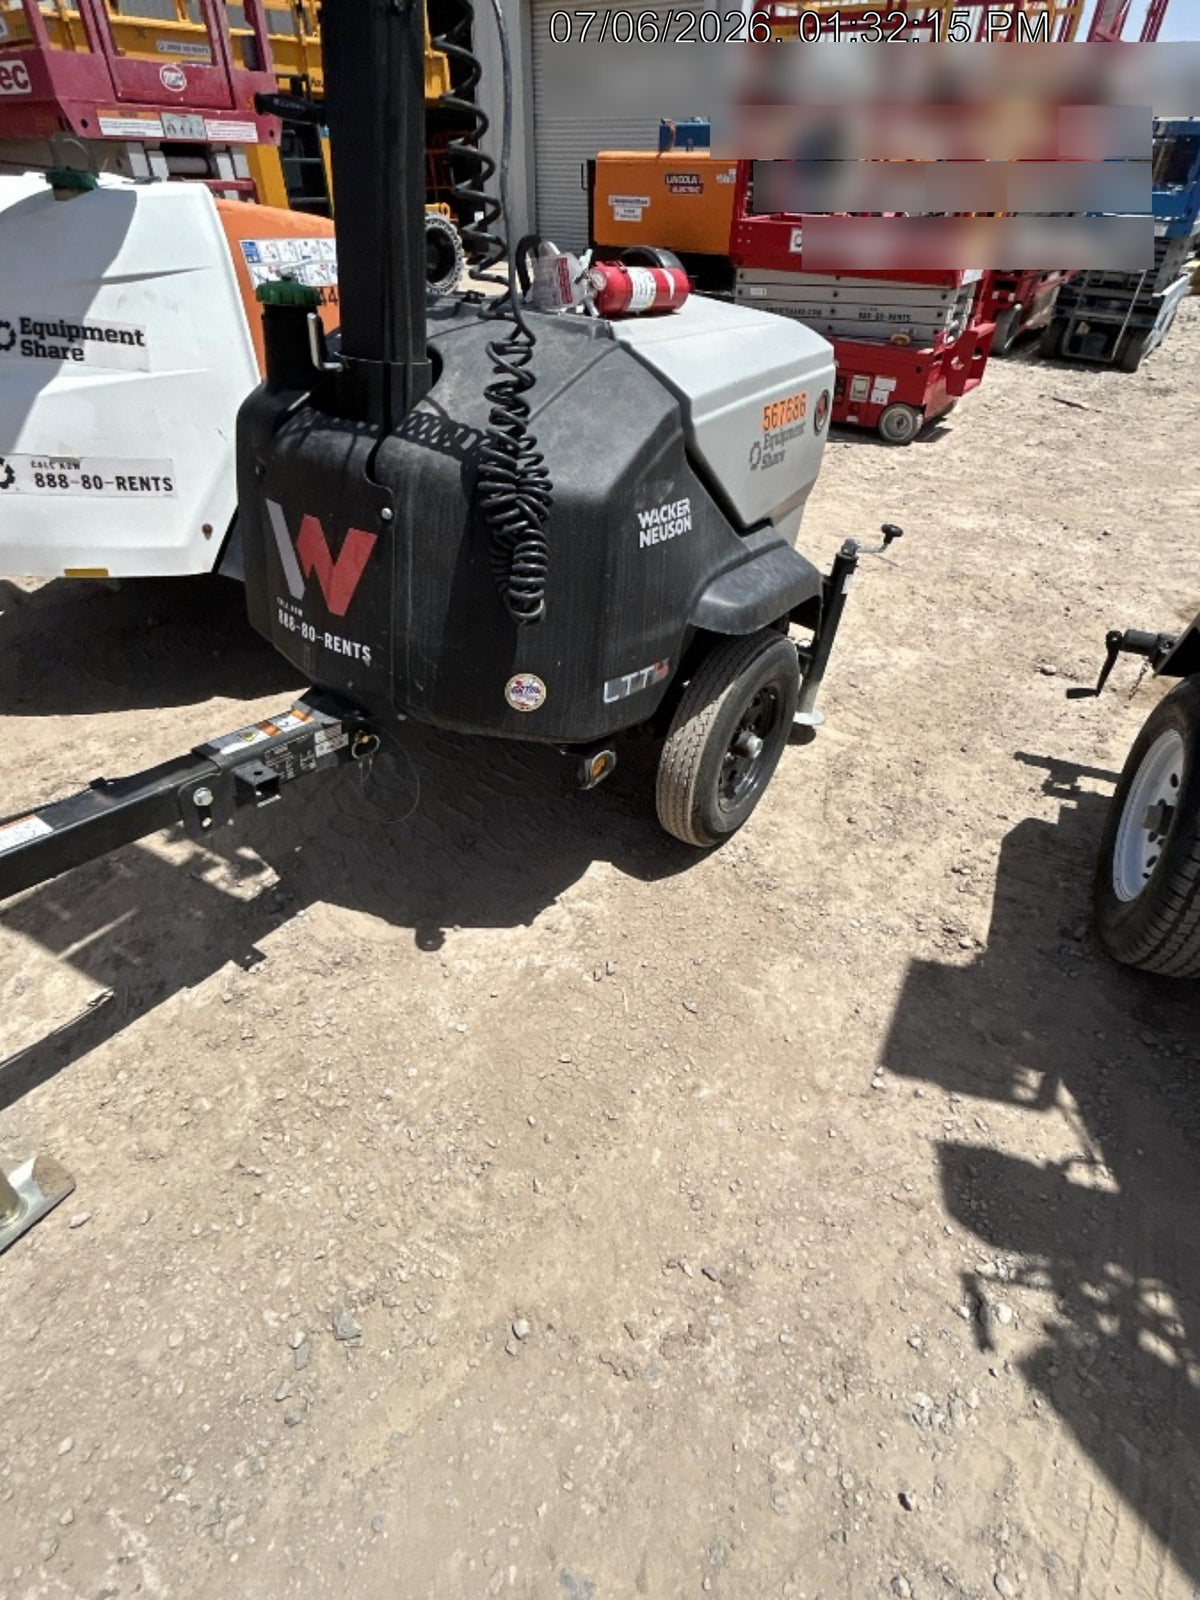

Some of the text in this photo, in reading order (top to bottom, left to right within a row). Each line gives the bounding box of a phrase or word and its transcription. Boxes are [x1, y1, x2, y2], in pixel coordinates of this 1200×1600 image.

[19, 317, 146, 347] Equipment
[20, 340, 85, 361] Share
[34, 472, 173, 492] 888-80-RENTS
[638, 498, 690, 529] WACKER
[639, 515, 692, 549] NEUSON
